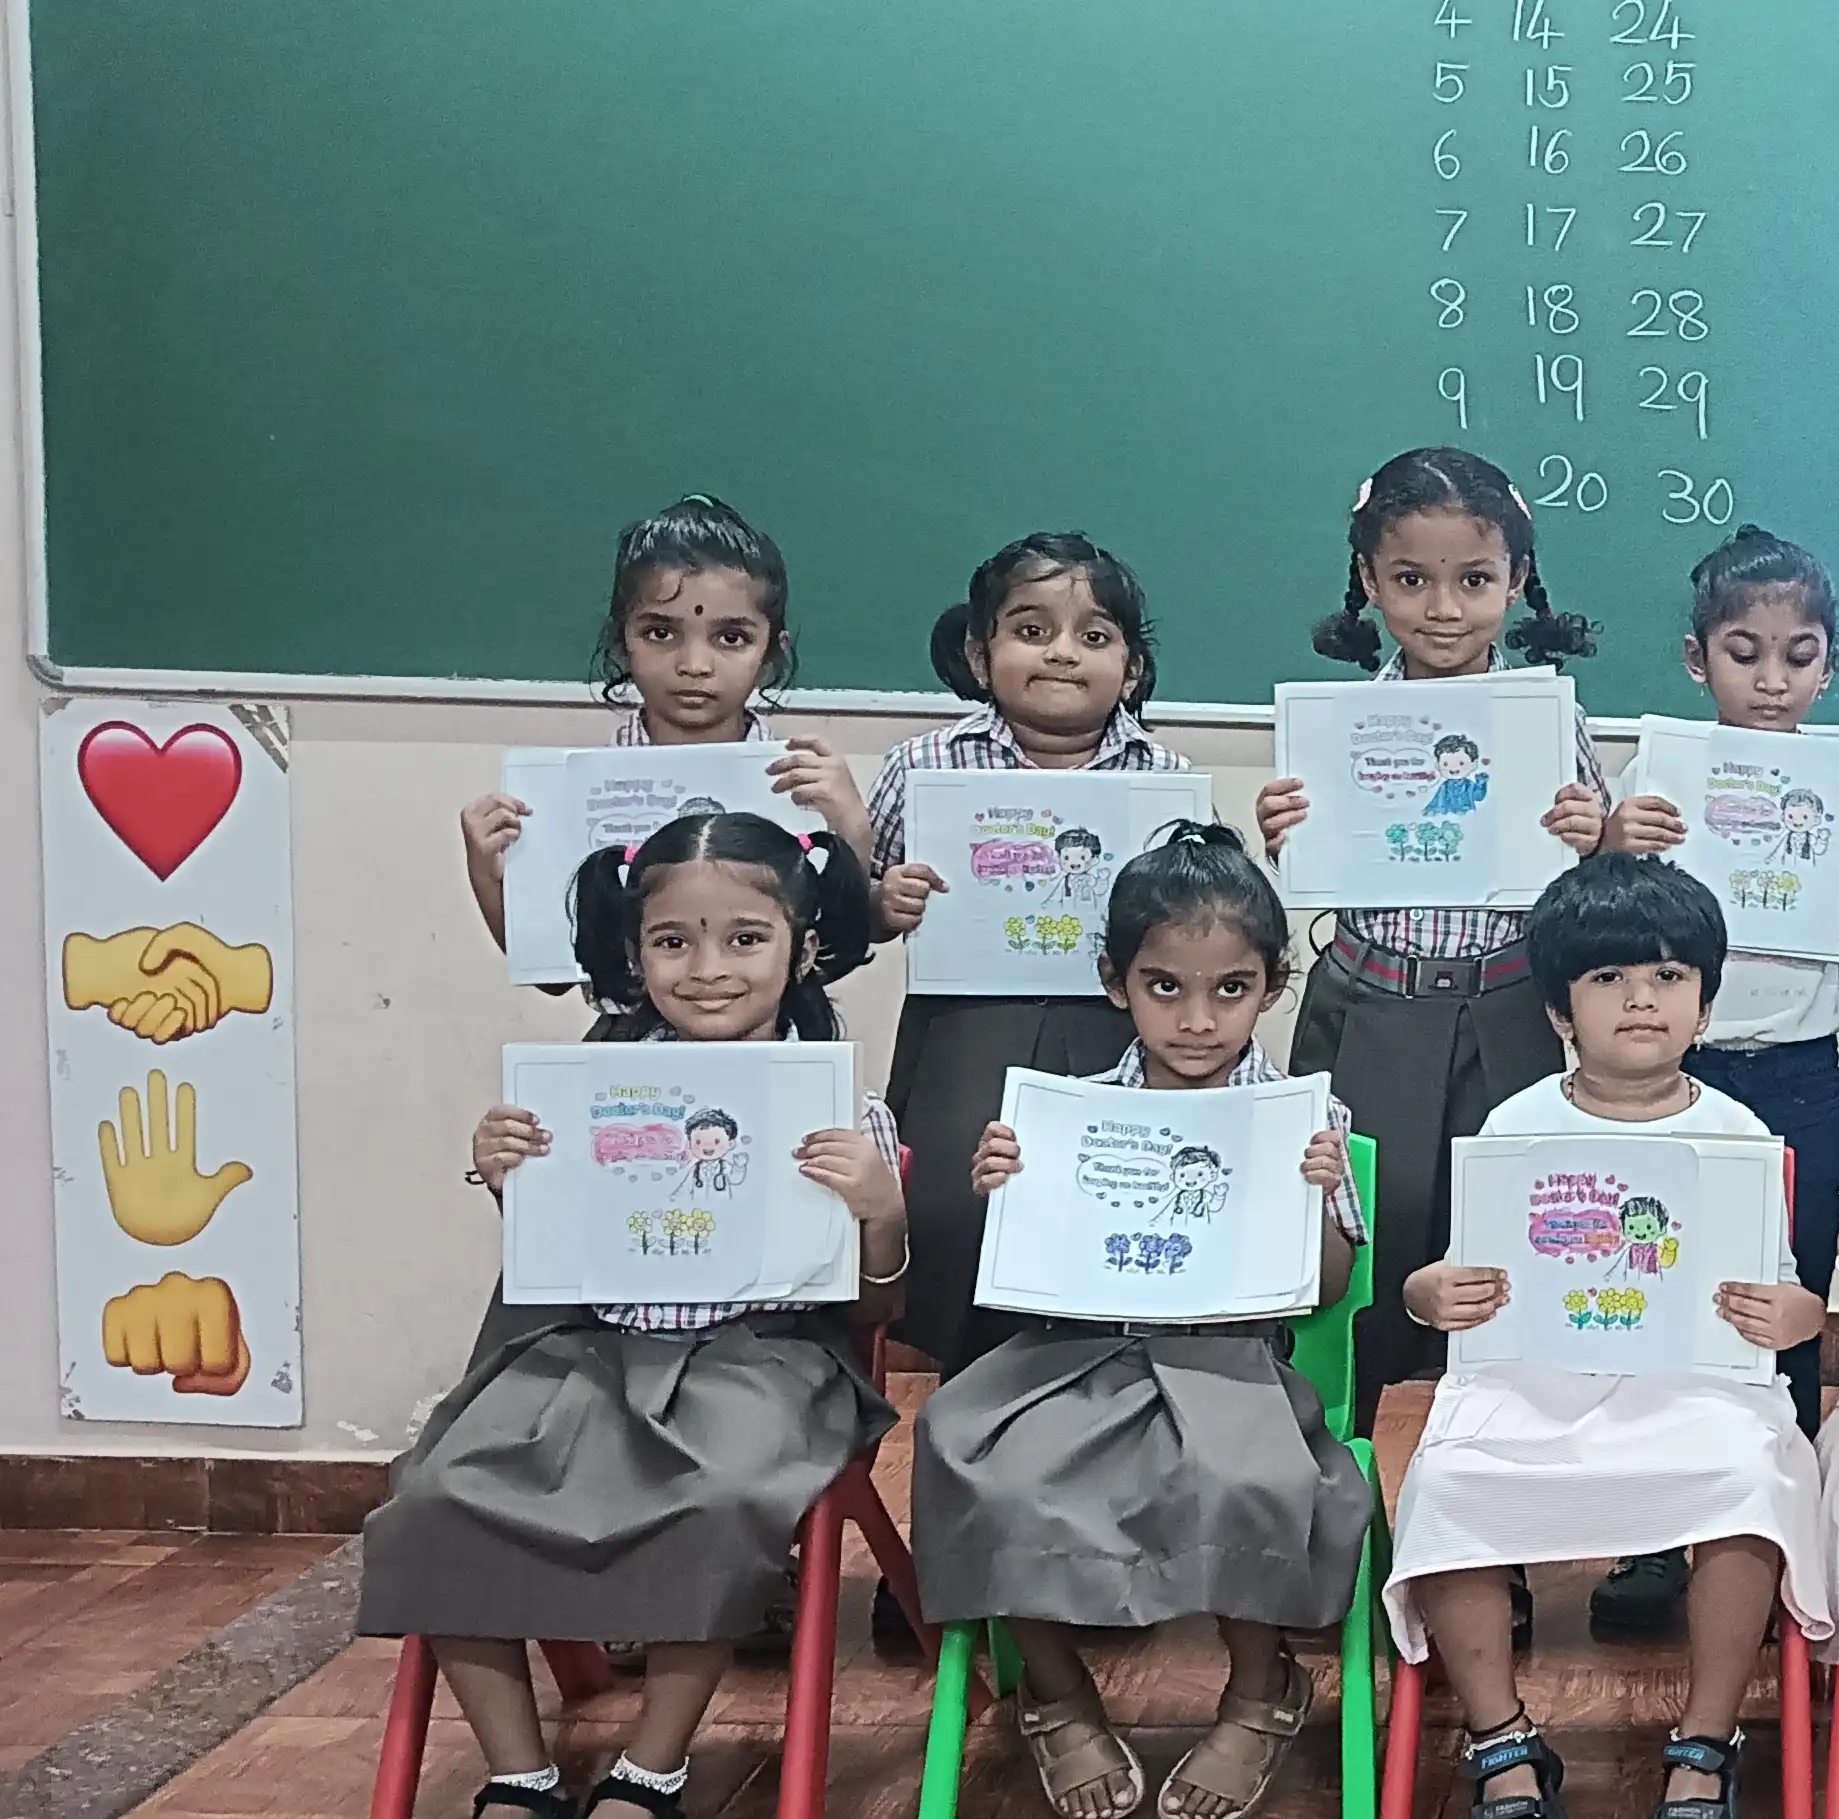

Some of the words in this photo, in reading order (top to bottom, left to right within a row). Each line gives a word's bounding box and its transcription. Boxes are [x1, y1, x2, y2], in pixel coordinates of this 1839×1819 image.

[1433, 0, 1472, 38] 4
[1511, 0, 1564, 49] 14
[1609, 0, 1696, 49] 24
[1432, 61, 1470, 103] 5
[1526, 65, 1572, 108] 15
[1622, 60, 1696, 104] 25
[1433, 129, 1460, 179] 6
[1529, 125, 1572, 174] 16
[1617, 130, 1687, 175] 26
[1434, 208, 1468, 252] 7
[1526, 203, 1577, 251] 17
[1629, 202, 1708, 253] 27
[1430, 277, 1466, 328] 8
[1526, 284, 1579, 334] 18
[1626, 289, 1709, 340] 28
[1437, 366, 1467, 428] 9
[1535, 353, 1584, 422] 19
[1639, 366, 1709, 439] 29
[1534, 454, 1608, 511] 20
[1658, 469, 1733, 524] 30
[1723, 761, 1764, 777] Happy
[987, 806, 1034, 822] Happy
[1027, 823, 1056, 839] Day!
[610, 1084, 662, 1100] Happy
[590, 1102, 651, 1119] Doctor's
[652, 1102, 687, 1121] Day!
[1101, 1120, 1151, 1138] Happy
[1081, 1135, 1139, 1150] Doctor's
[1141, 1140, 1173, 1156] Day!
[1093, 1162, 1122, 1174] Thank
[1548, 1172, 1597, 1189] Happy
[1481, 1745, 1528, 1769] FIGHTER
